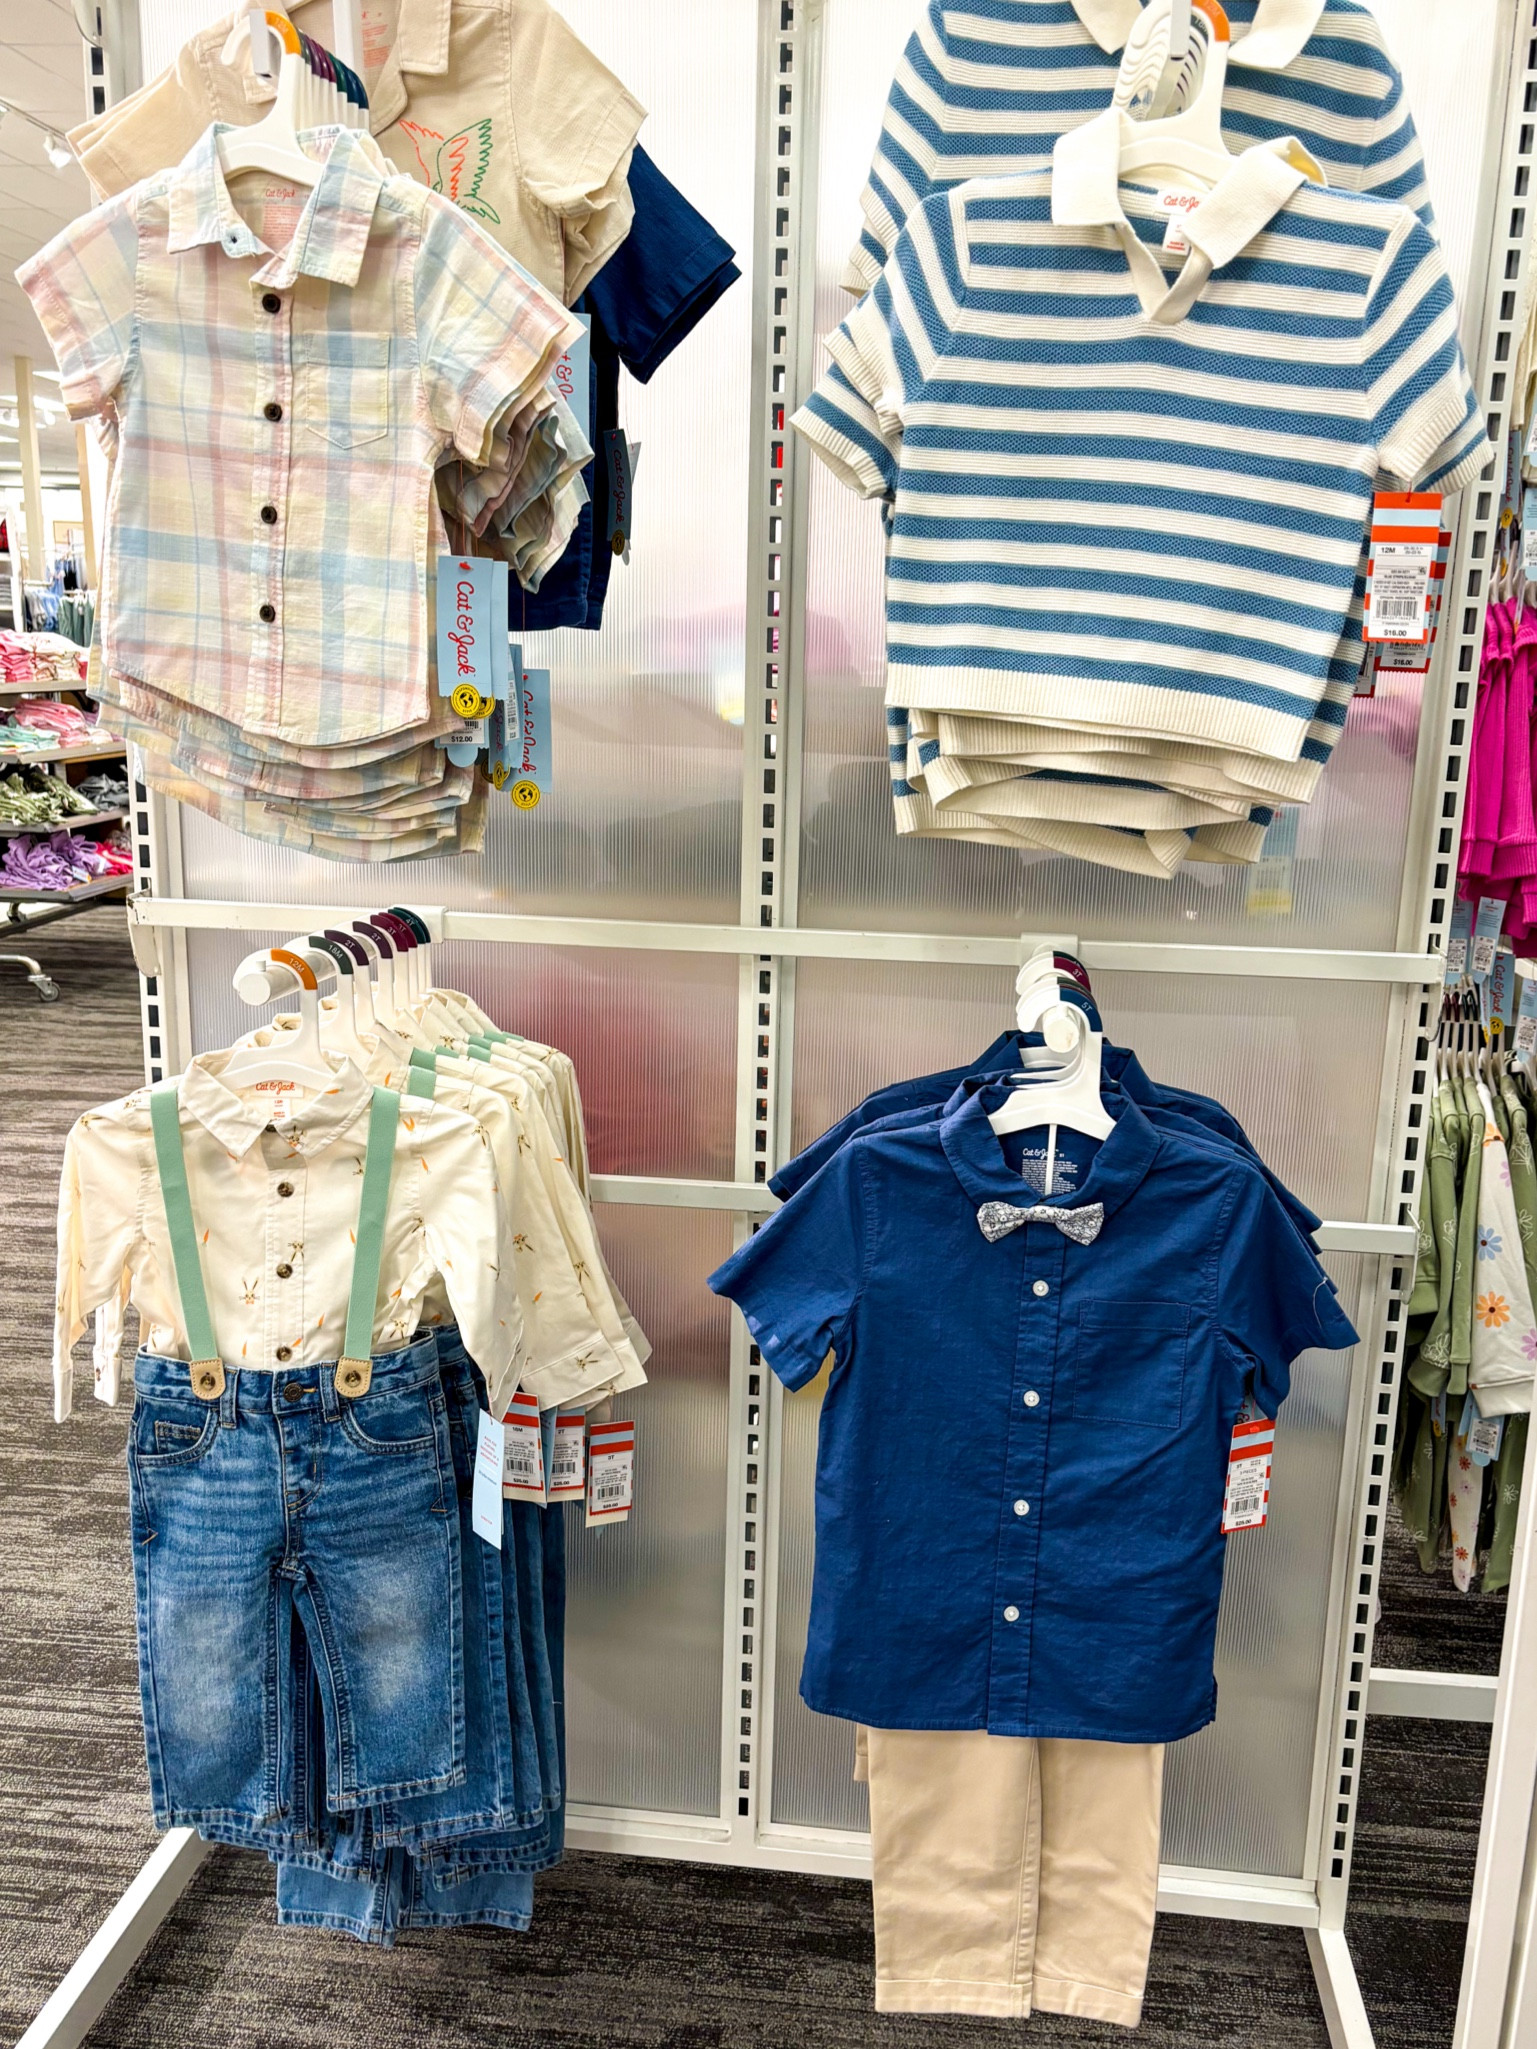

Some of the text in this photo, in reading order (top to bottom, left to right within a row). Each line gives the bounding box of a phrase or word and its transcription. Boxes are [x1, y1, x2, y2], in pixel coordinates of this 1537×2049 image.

[266, 188, 276, 198] Cat
[282, 188, 296, 201] Jack
[1163, 195, 1178, 206] Cat
[1179, 196, 1188, 207] &
[555, 364, 573, 382] &
[612, 449, 626, 524] Cat & Jack
[447, 580, 477, 678] Cat & Jack
[1384, 629, 1407, 637] $16.00
[451, 735, 473, 743] $12.00
[519, 736, 538, 775] Jack
[387, 926, 397, 936] 3T
[371, 932, 382, 943] 2T
[344, 939, 356, 950] 2T
[328, 944, 344, 959] 18M
[288, 957, 305, 973] 12M
[1072, 968, 1083, 978] 3T
[1489, 964, 1506, 1014] Cat & Jack
[1081, 1001, 1093, 1012] 5T
[255, 1081, 295, 1095] Cat & Jack
[1022, 1148, 1034, 1156] Cat
